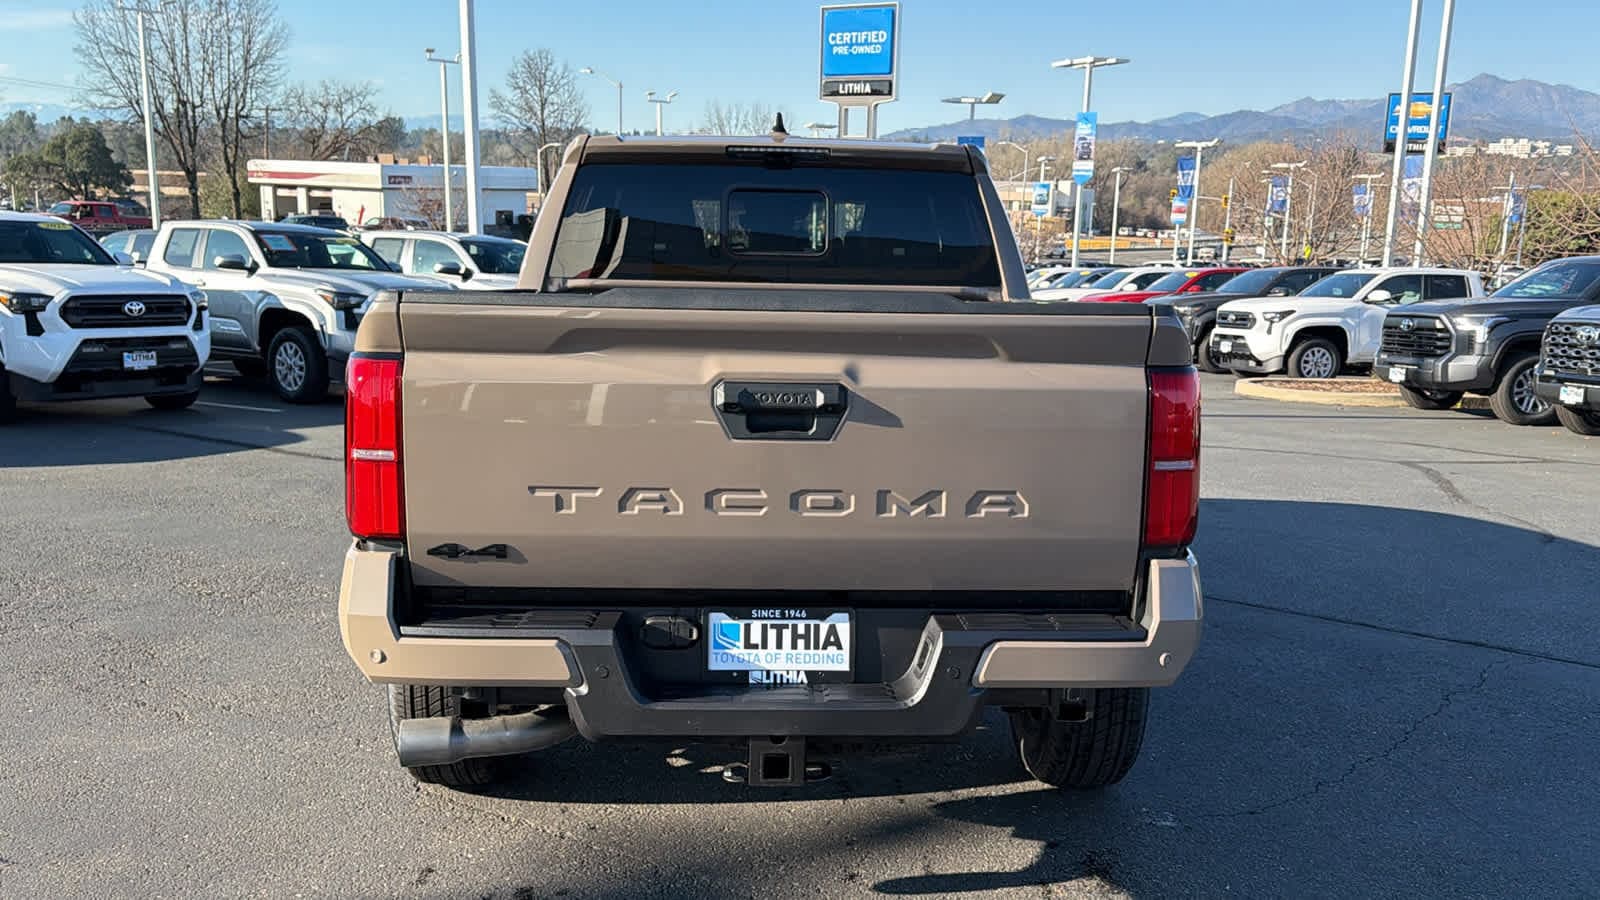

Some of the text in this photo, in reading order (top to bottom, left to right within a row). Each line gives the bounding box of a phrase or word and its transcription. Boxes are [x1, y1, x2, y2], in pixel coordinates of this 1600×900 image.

[828, 31, 887, 44] CERTIFIED
[833, 45, 882, 55] PRE-OWNED
[839, 82, 871, 94] LITHIA
[753, 392, 814, 405] TOYOTA
[528, 486, 1029, 518] TACOMA
[751, 609, 807, 618] SINCE 1946
[743, 623, 843, 650] LITHIA
[713, 652, 844, 664] TOYOTA OF REDDING
[762, 670, 808, 684] LITHIA
